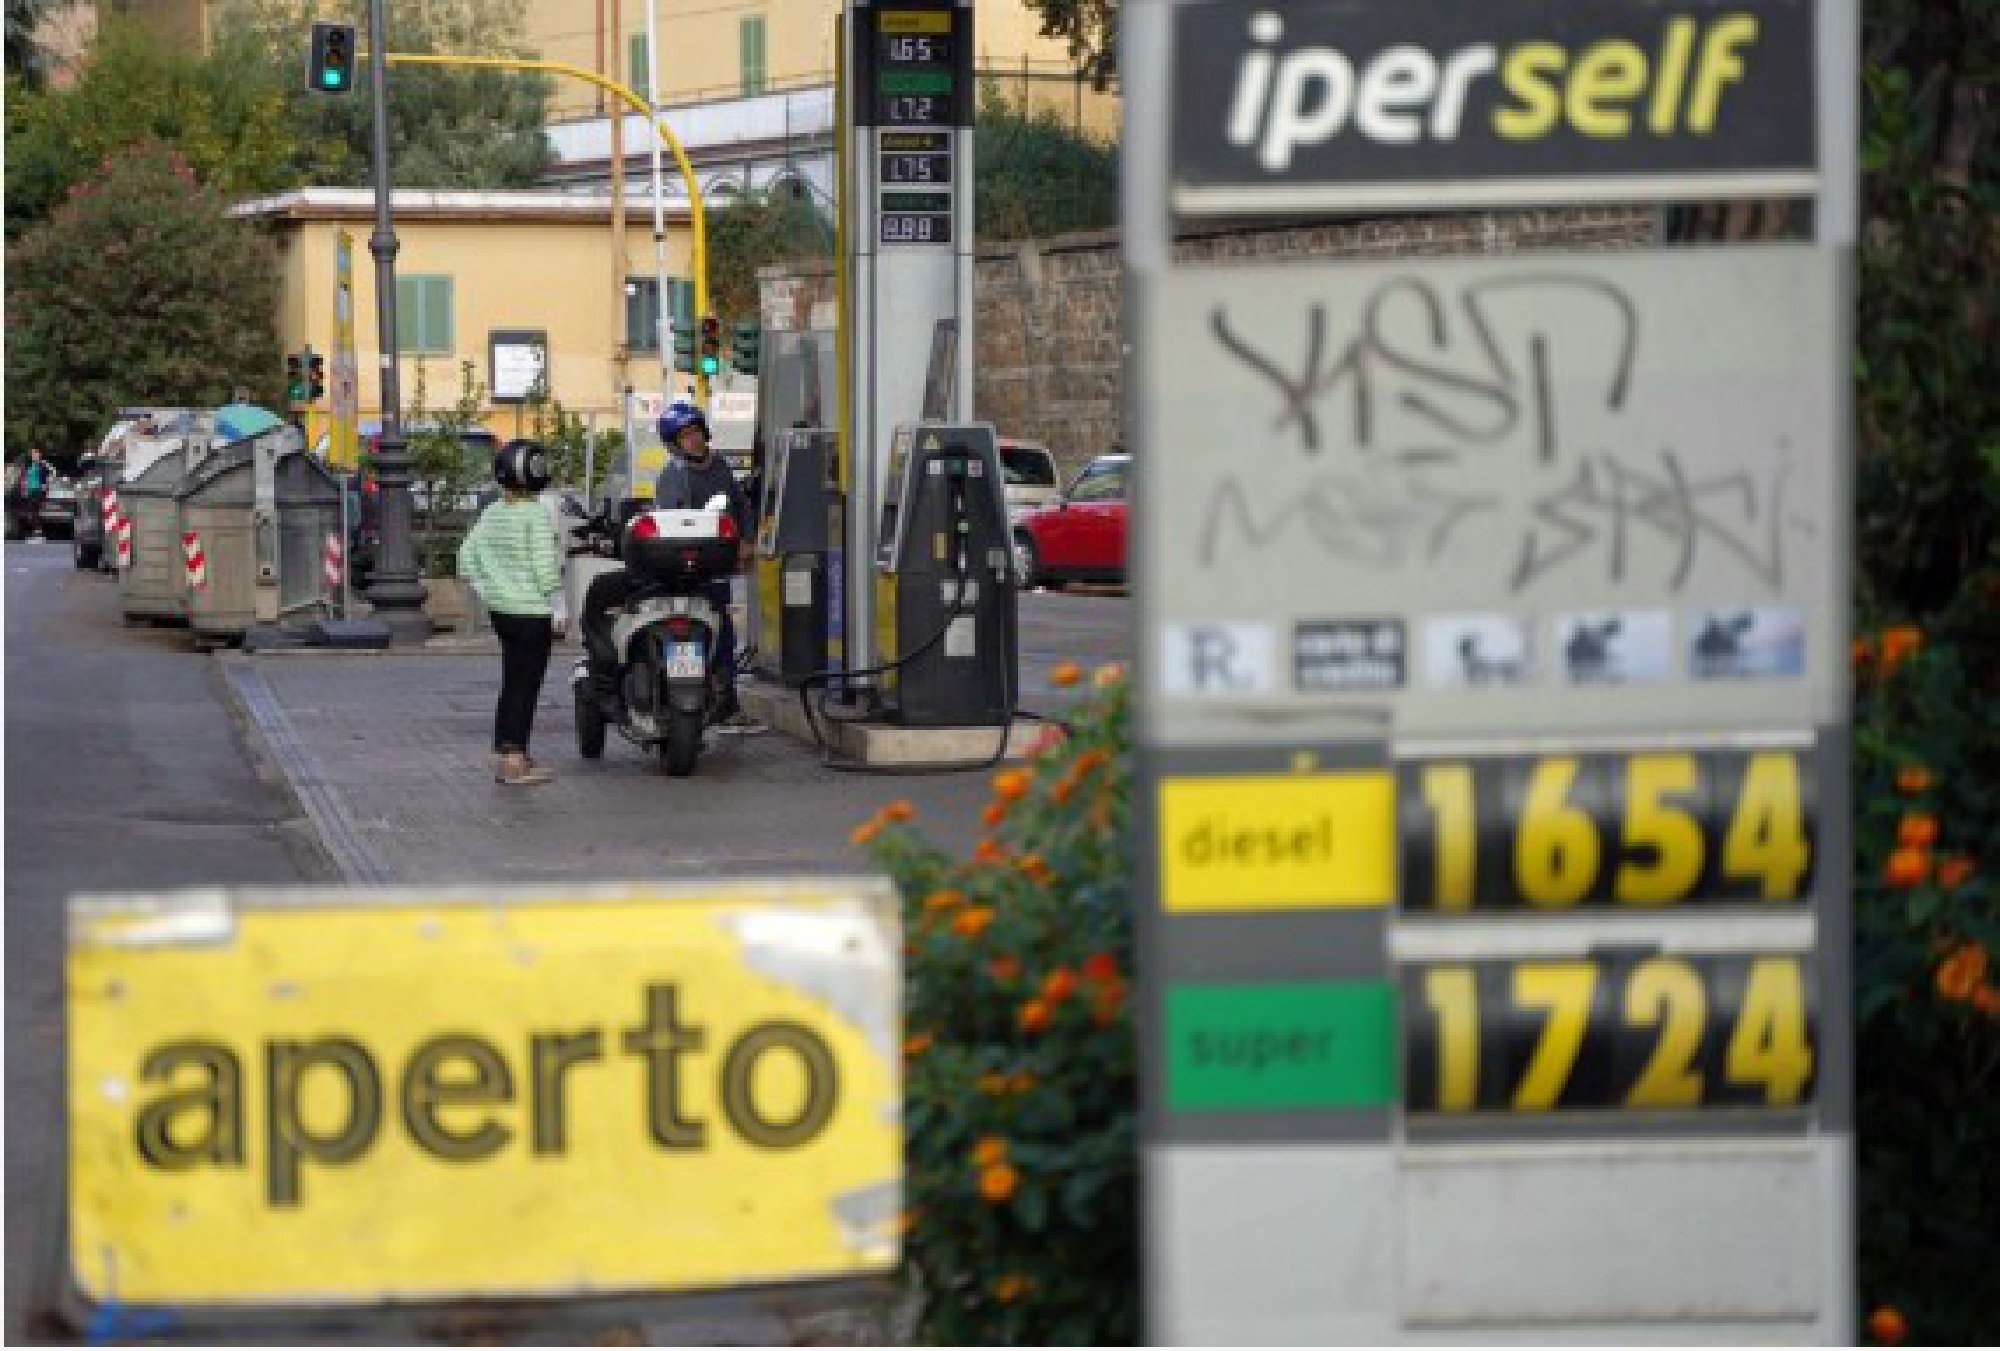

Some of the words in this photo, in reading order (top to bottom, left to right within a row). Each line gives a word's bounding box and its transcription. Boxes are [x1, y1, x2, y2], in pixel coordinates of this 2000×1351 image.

[1227, 9, 1759, 171] iperself
[1181, 811, 1333, 870] diesel
[1424, 752, 1812, 914] 1654
[131, 979, 841, 1207] aperto
[1187, 1025, 1336, 1077] super
[1425, 955, 1814, 1114] 1724
